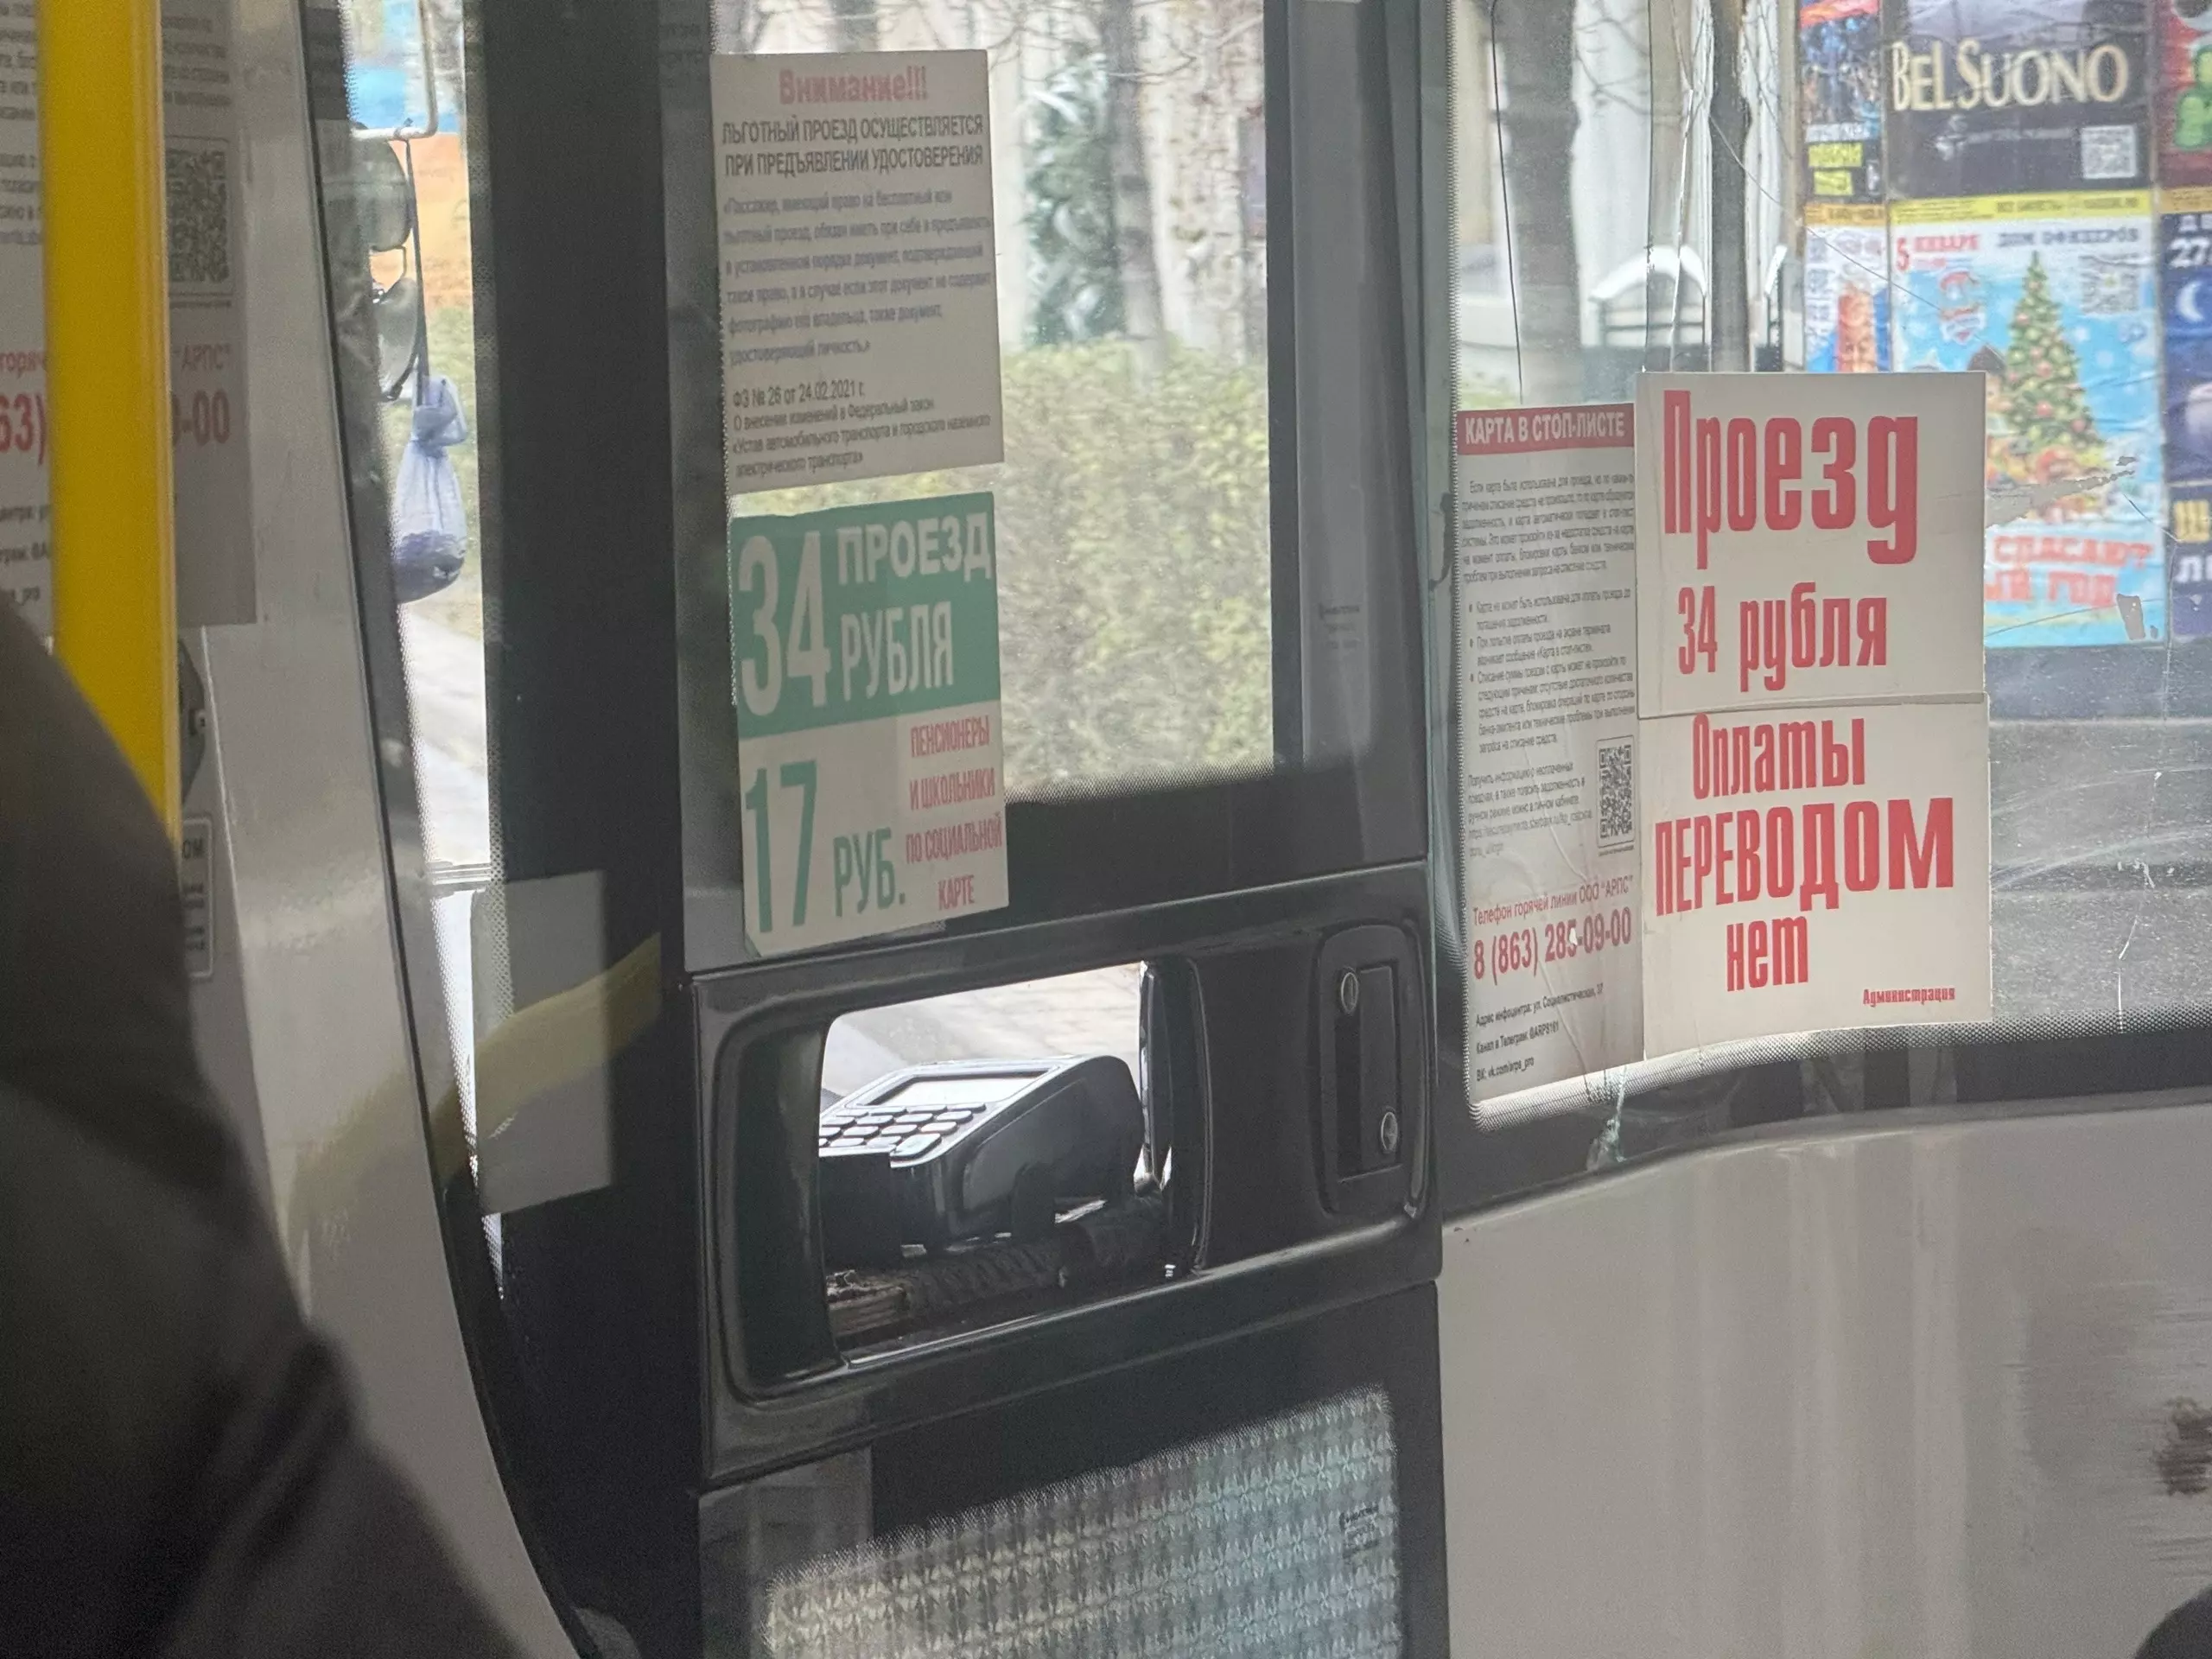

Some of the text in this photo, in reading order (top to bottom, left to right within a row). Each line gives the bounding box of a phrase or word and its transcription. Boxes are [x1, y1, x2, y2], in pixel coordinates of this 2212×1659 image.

[722, 114, 983, 145] ЛЬГОТНЫЙ ПРОЕЗД ОСУЩЕСТВЛЯЕТСЯ
[725, 144, 983, 179] ПРИ ПРЕДЪЯВЛЕНИИ УДОСТОВЕРЕНИЯ
[768, 385, 782, 406] 26
[798, 379, 855, 403] 24.02.2021
[1465, 411, 1624, 445] КАРТА В СТОП-ЛИСТЕ
[1663, 390, 1918, 570] Проезд
[836, 512, 992, 585] ПРОЕЗД
[739, 531, 831, 716] 34
[840, 601, 954, 702] РУБЛЯ
[1678, 582, 1887, 693] 34 рубля
[910, 715, 990, 758] ПЕНСИОНЕРЫ
[1693, 713, 1866, 799] Оплаты
[909, 767, 995, 810] И ШКОЛЬНИКИ
[745, 760, 906, 933] 17 РУБ.
[906, 810, 1002, 864] ПО СОЦИАЛЬНОЙ
[1656, 797, 1955, 917] ПЕРЕВОДОМ
[938, 874, 975, 911] КАРТЕ
[1472, 906, 1512, 928] Телефон
[1514, 892, 1549, 920] горячей
[1551, 891, 1578, 910] линии
[1580, 882, 1599, 903] ООО
[1474, 906, 1631, 986] 8 (863) 285-09-00
[1726, 915, 1808, 992] нет
[1862, 987, 1955, 1007] Администрация
